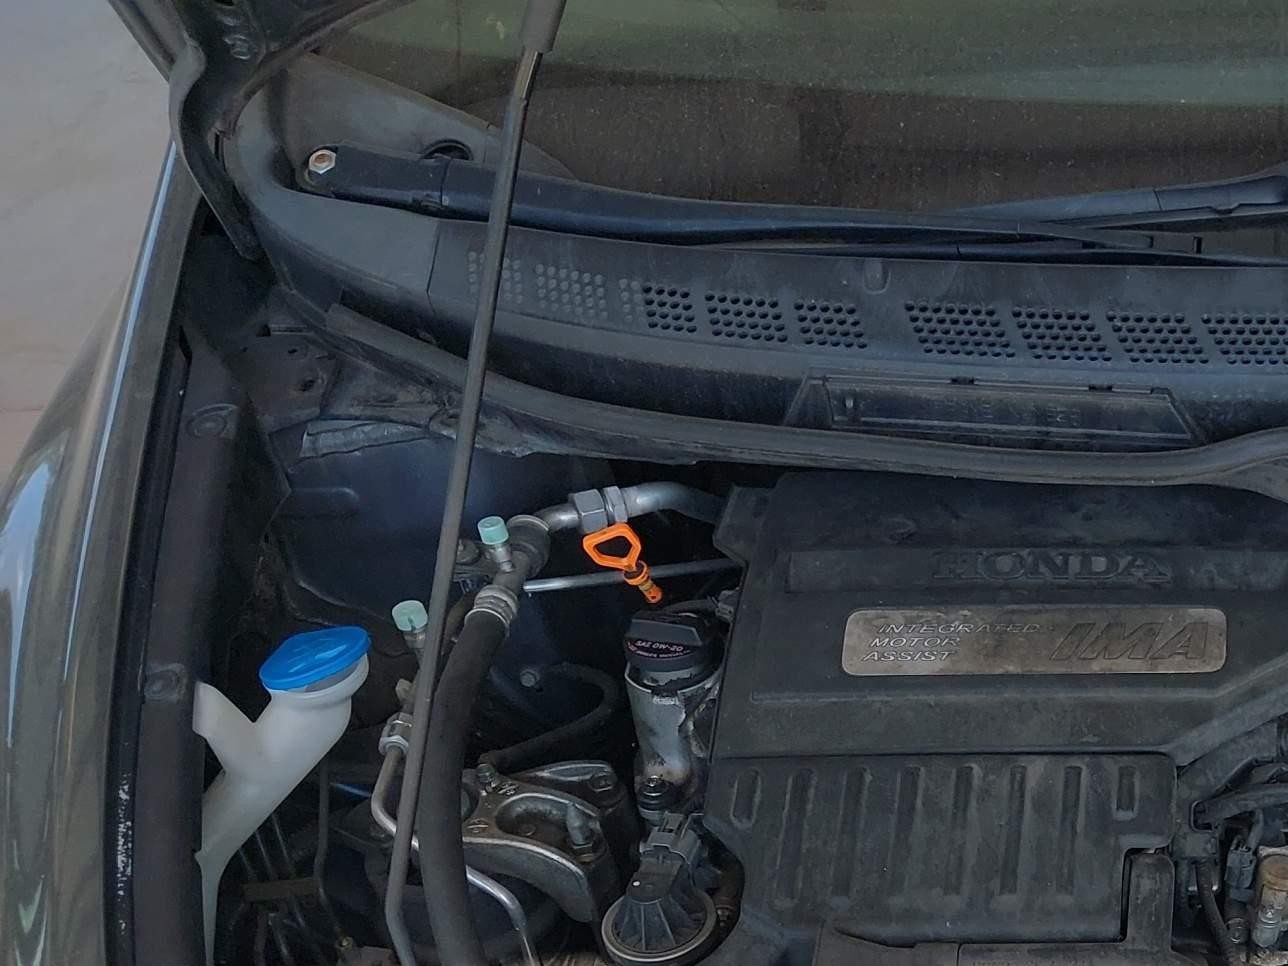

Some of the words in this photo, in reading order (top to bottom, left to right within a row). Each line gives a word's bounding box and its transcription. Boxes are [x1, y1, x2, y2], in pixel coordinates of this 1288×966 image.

[933, 549, 1171, 584] HONDA
[878, 622, 1042, 635] INTEGRATED
[870, 636, 961, 649] MOTOR
[1050, 621, 1210, 661] IMA
[862, 650, 954, 662] ASSIST
